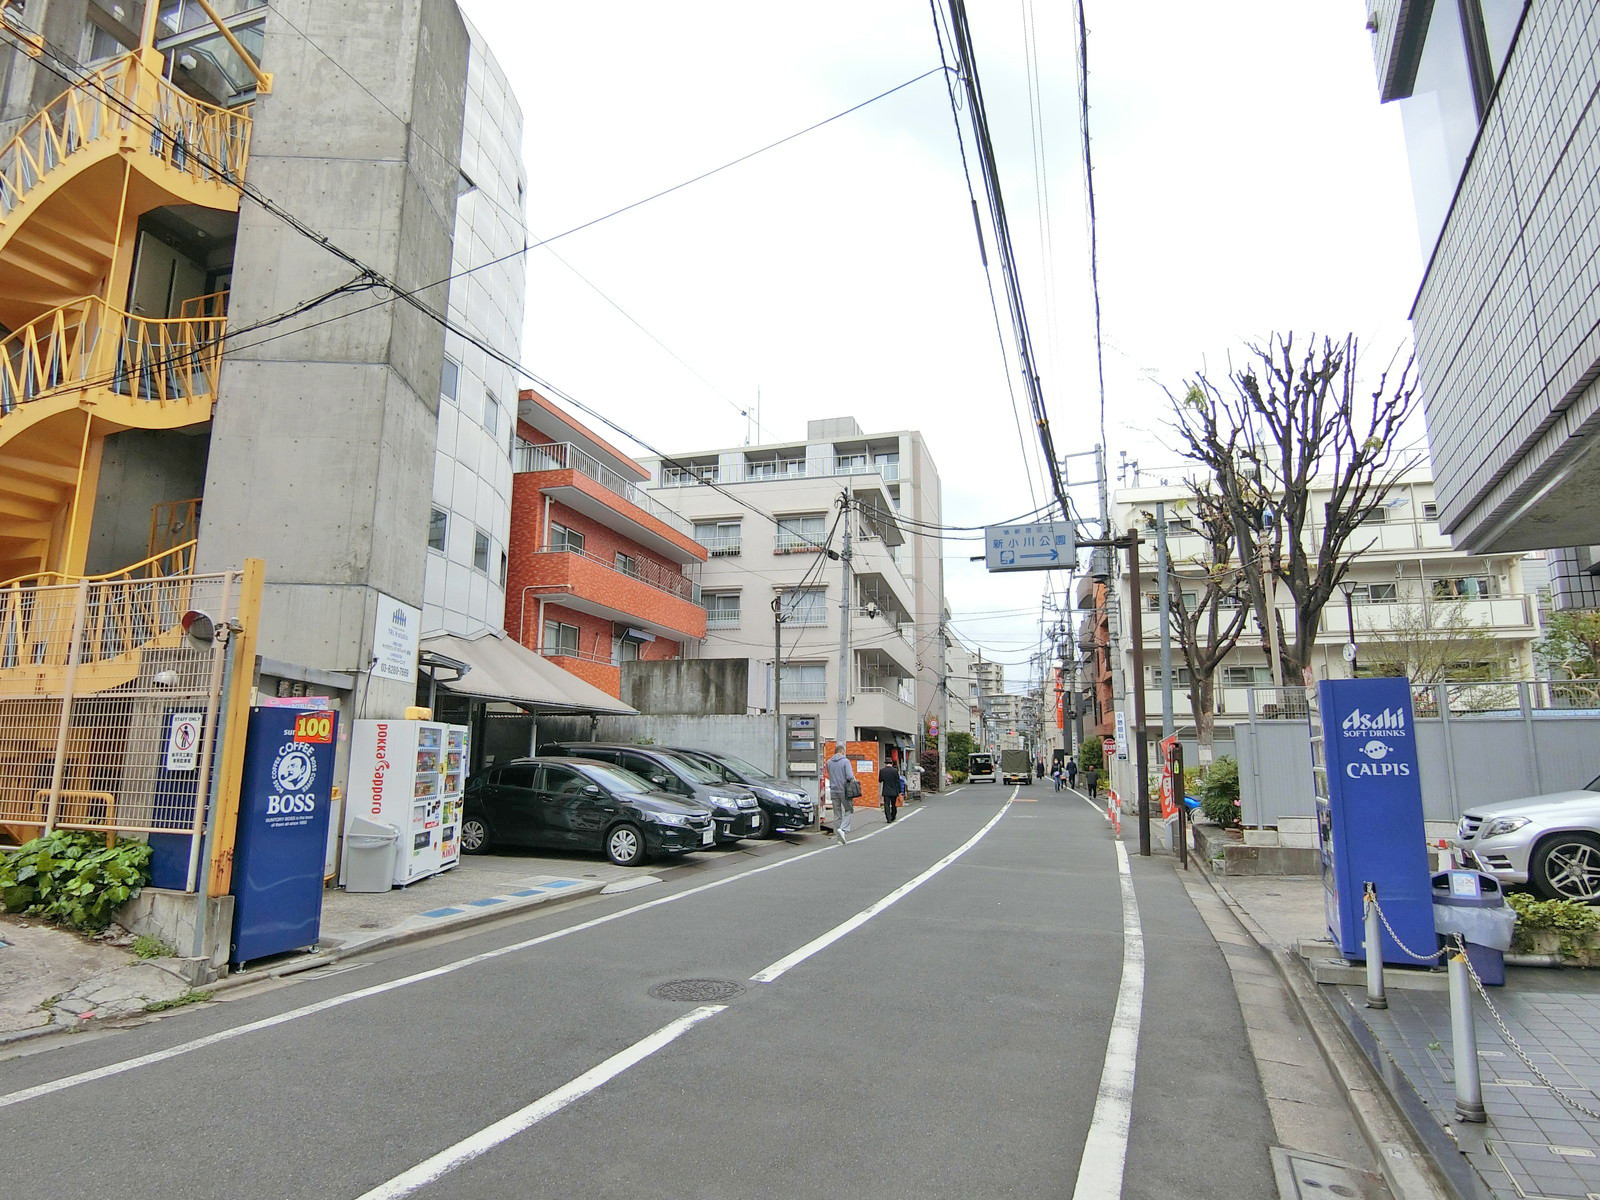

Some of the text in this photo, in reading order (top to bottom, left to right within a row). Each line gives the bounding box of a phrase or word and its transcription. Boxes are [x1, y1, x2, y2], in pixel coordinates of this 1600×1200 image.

[993, 535, 1066, 549] 新小川公園
[297, 717, 331, 737] 100
[1342, 707, 1405, 729] Asahi
[1369, 729, 1406, 737] DRINKS
[279, 741, 315, 757] COFFEE
[271, 756, 281, 779] COFFEE
[1346, 762, 1410, 779] CALPIS
[302, 772, 316, 793] COFFEE
[266, 793, 315, 815] BOSS
